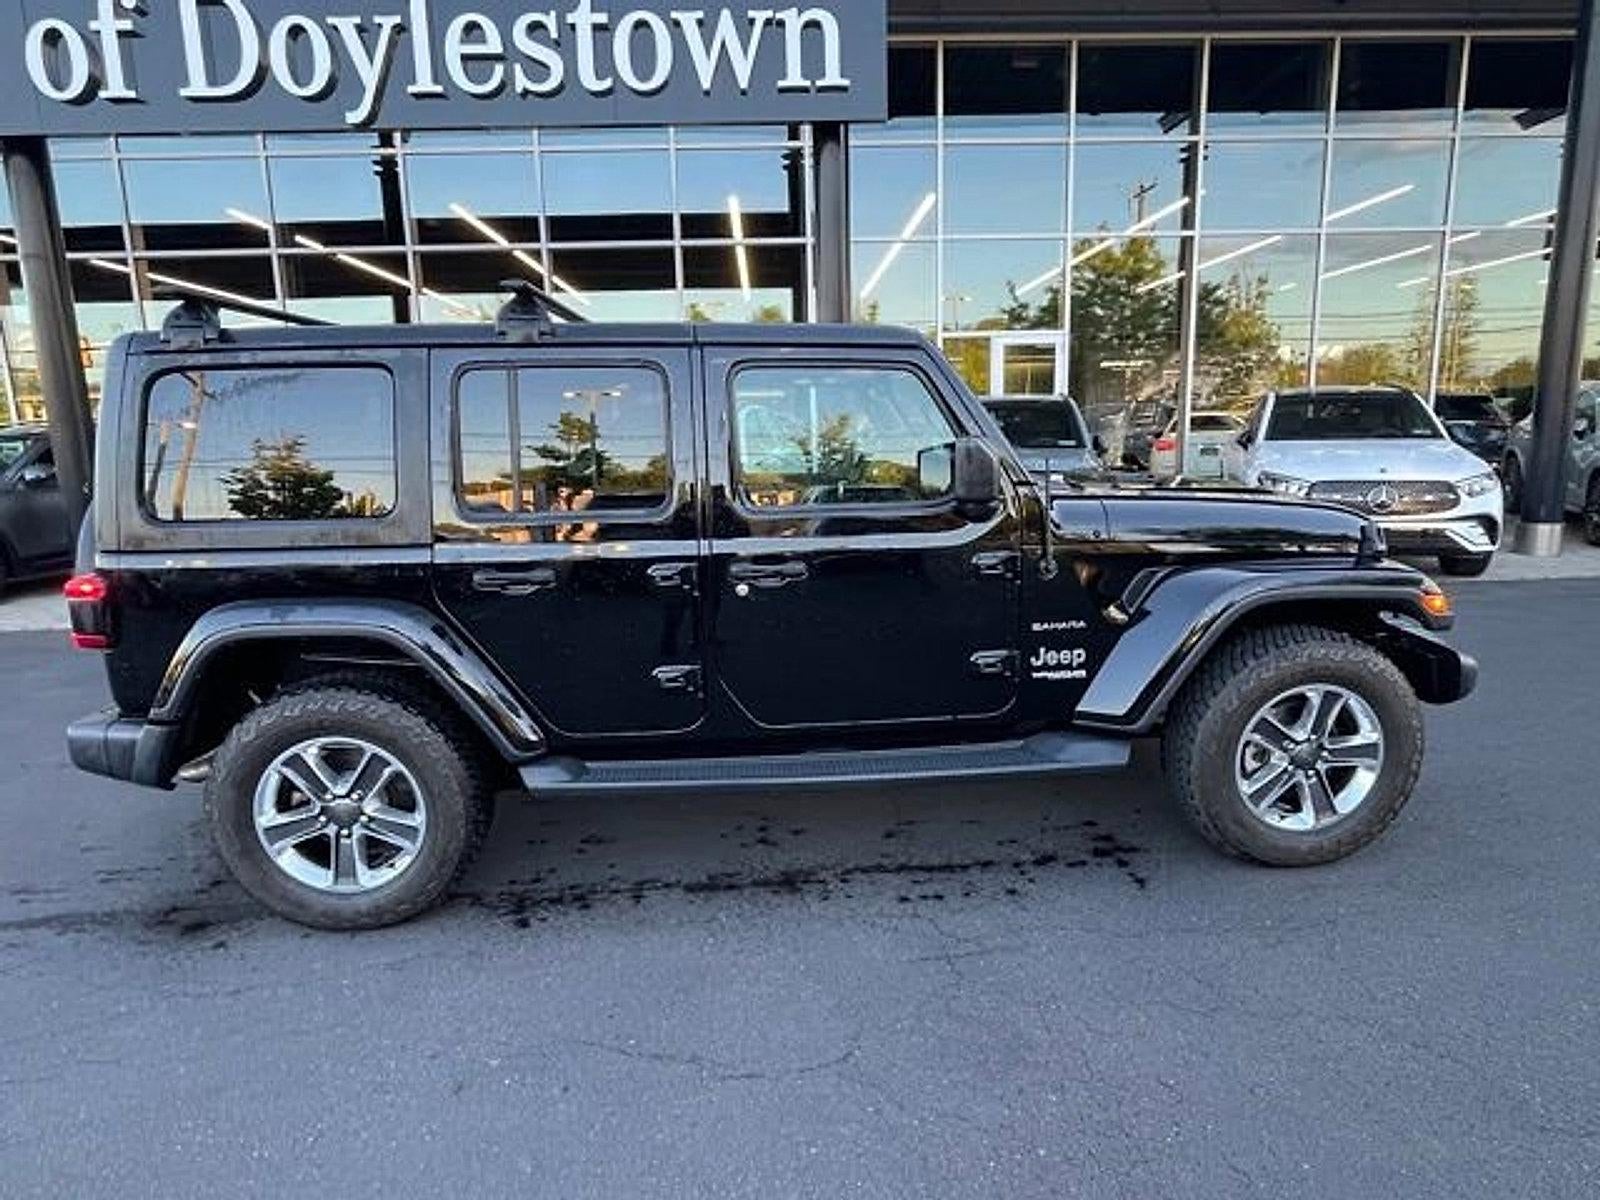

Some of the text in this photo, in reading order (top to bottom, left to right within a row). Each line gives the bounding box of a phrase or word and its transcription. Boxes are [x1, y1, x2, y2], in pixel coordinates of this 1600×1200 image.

[25, 0, 852, 126] of Doylestown
[1029, 646, 1087, 668] Jeep
